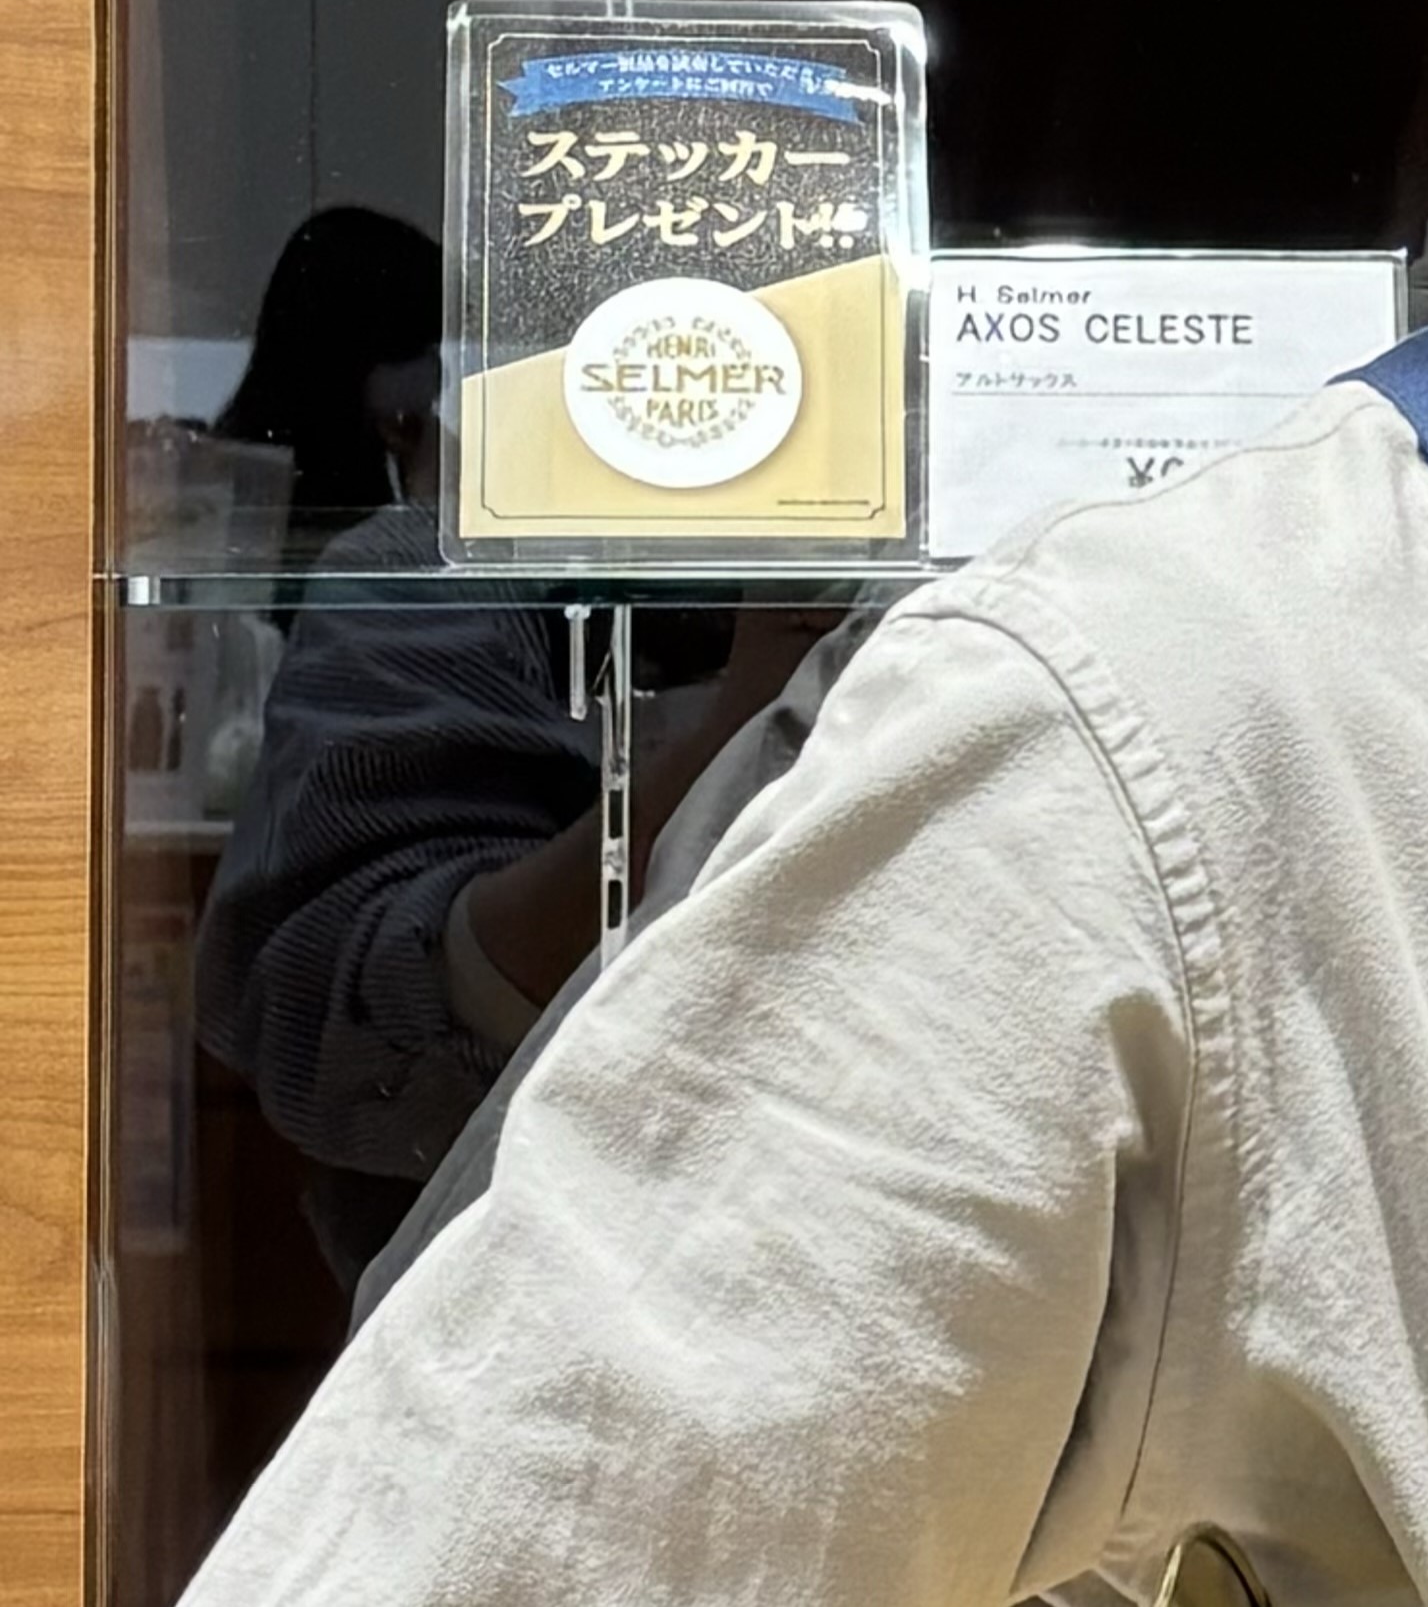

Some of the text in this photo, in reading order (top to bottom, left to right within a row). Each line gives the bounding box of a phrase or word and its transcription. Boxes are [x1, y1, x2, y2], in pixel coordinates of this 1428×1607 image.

[521, 130, 850, 186] ステッカー
[956, 313, 1254, 344] AXOS CELESTE
[646, 333, 717, 360] HENRI
[580, 363, 786, 395] SELMER
[956, 372, 1078, 389] アルトサックス
[646, 398, 719, 428] PARIS
